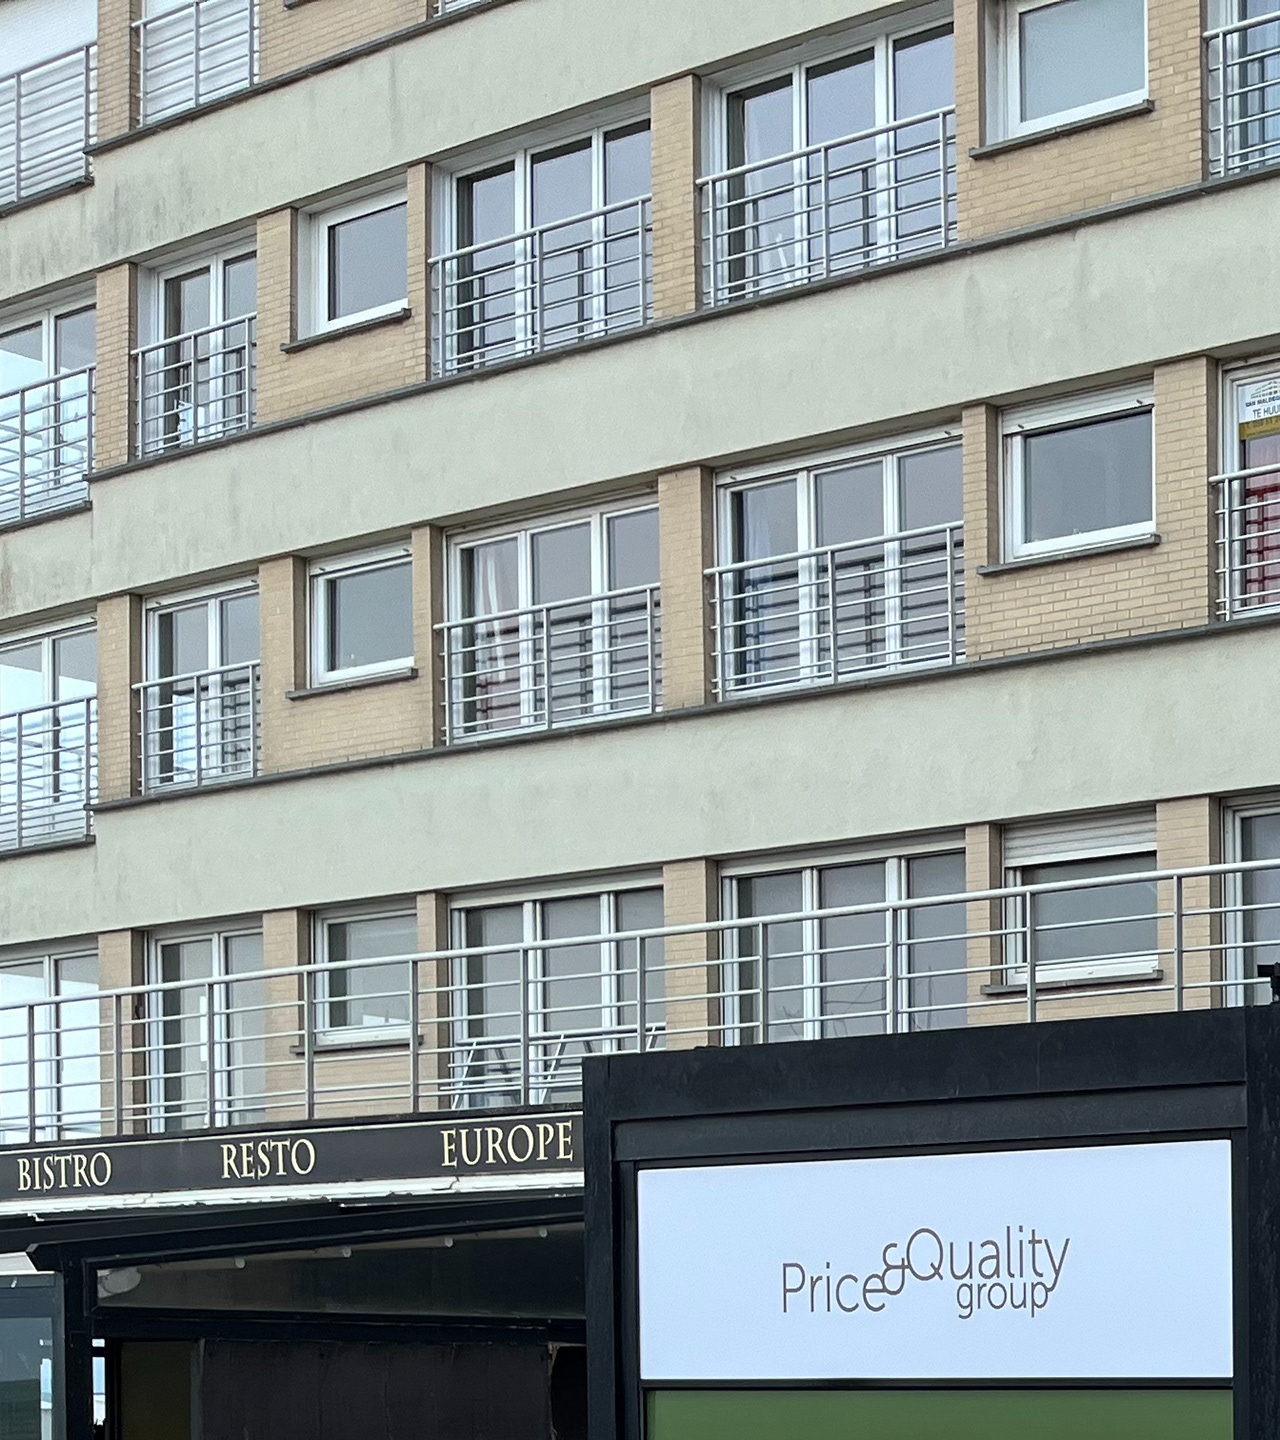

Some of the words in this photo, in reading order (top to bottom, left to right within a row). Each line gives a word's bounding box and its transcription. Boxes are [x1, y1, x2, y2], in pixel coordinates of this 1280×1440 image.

[1252, 408, 1262, 419] TE
[17, 1151, 112, 1193] BISTRO
[221, 1138, 316, 1180] RESTO
[441, 1121, 574, 1169] EUROPE
[956, 1281, 1049, 1320] group
